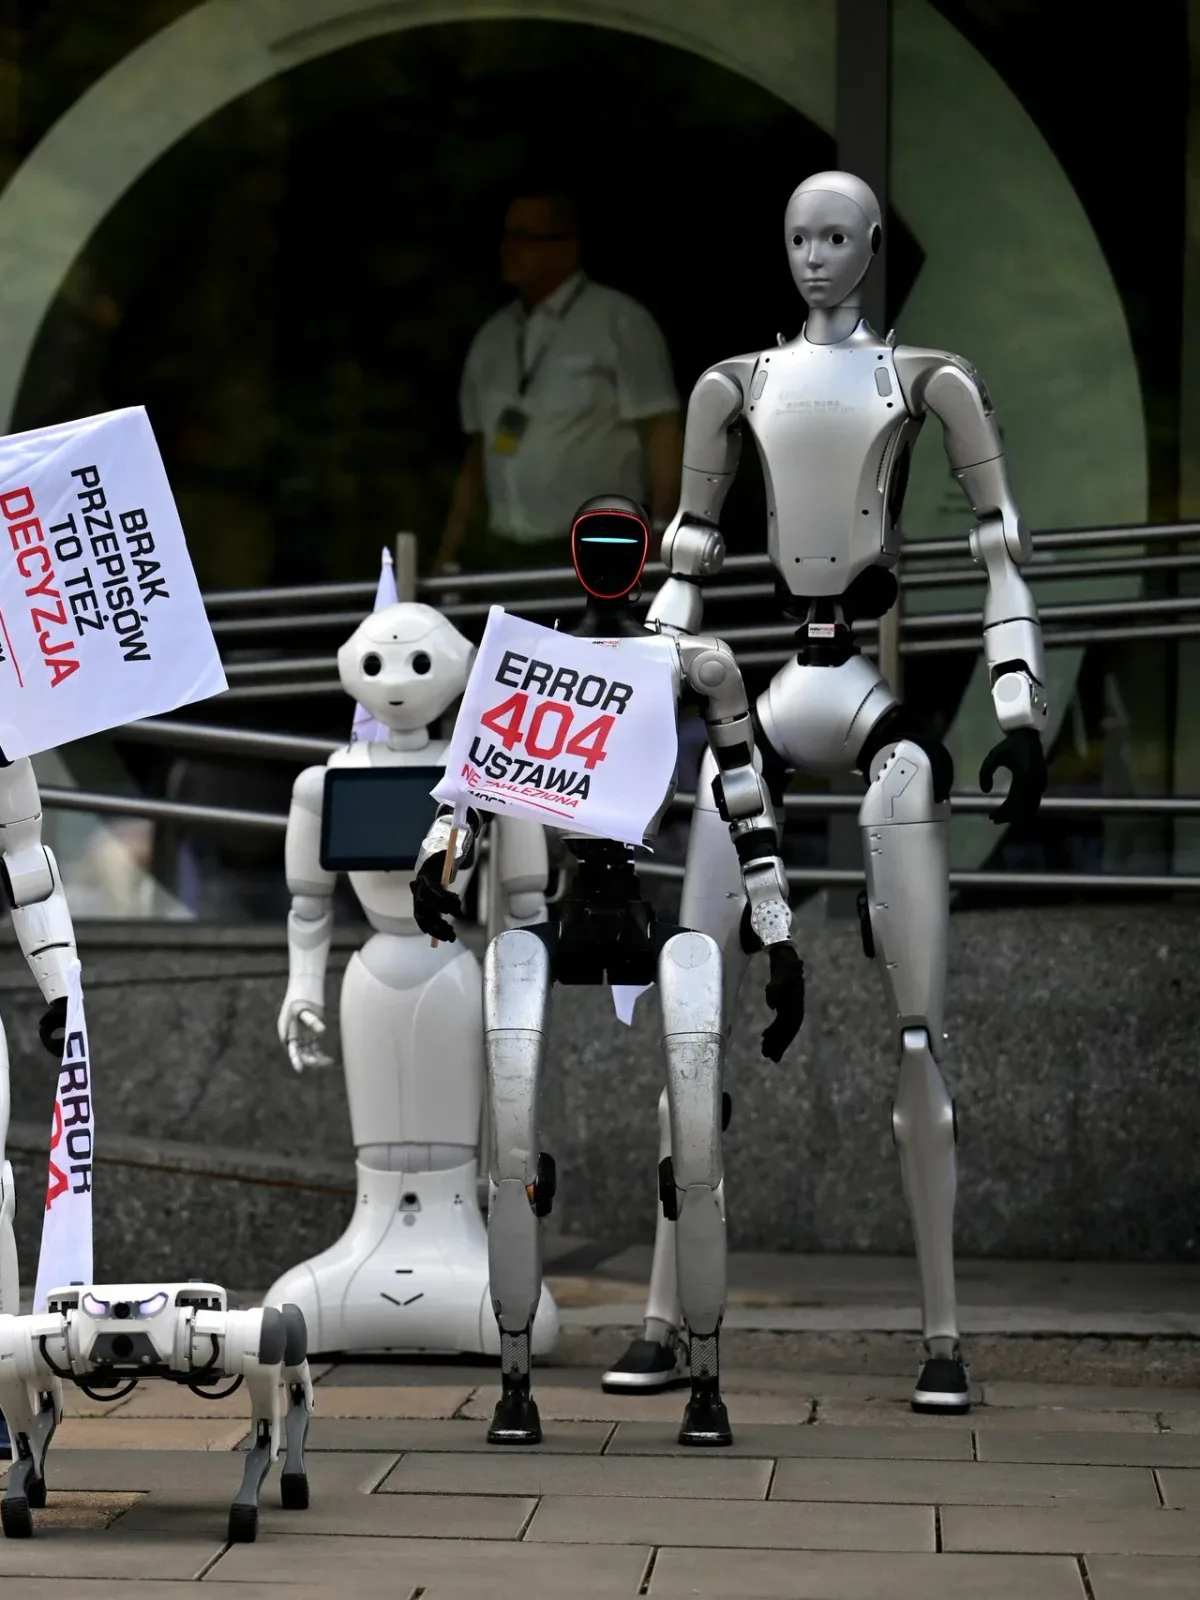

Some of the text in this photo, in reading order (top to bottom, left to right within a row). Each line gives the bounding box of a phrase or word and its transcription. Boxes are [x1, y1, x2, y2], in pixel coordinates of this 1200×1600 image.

[49, 513, 110, 636] TO TEŻ
[70, 464, 151, 662] PRZEPISÓW
[119, 508, 170, 605] BRAK
[495, 650, 634, 715] ERROR
[468, 736, 591, 800] USTAWA
[480, 692, 616, 770] 404
